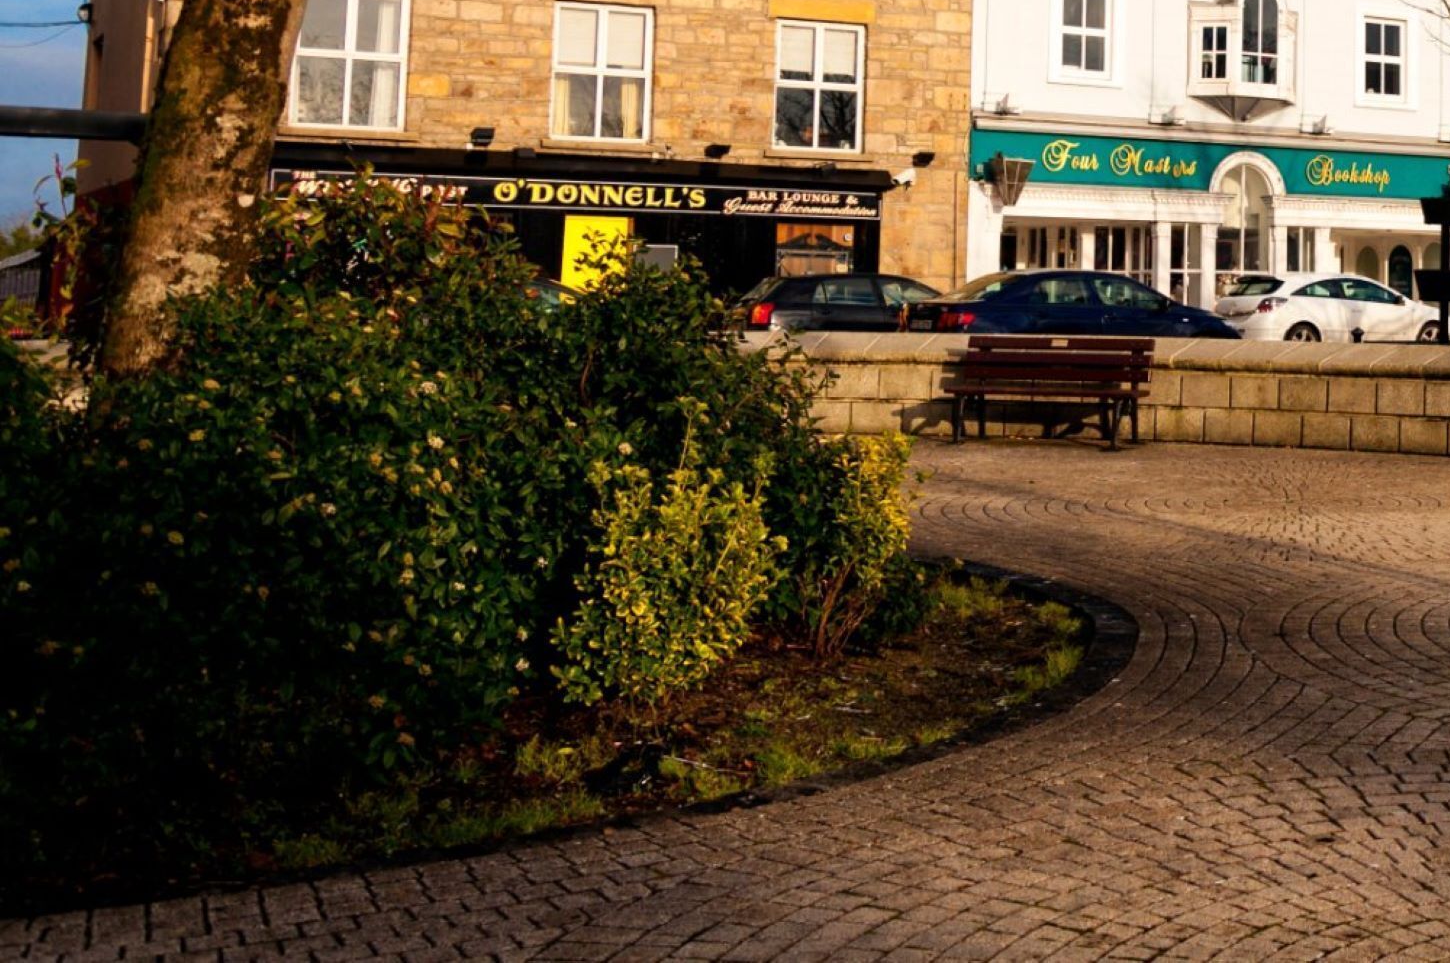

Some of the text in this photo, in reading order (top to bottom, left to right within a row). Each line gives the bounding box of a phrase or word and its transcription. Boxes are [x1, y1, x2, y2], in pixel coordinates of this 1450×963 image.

[1042, 139, 1198, 177] Four Masters
[1306, 154, 1390, 193] Bookshop
[494, 178, 707, 208] O'DONNELL'S
[723, 196, 877, 216] Guest Accommodation
[747, 190, 859, 205] BAR LOUNGE &
